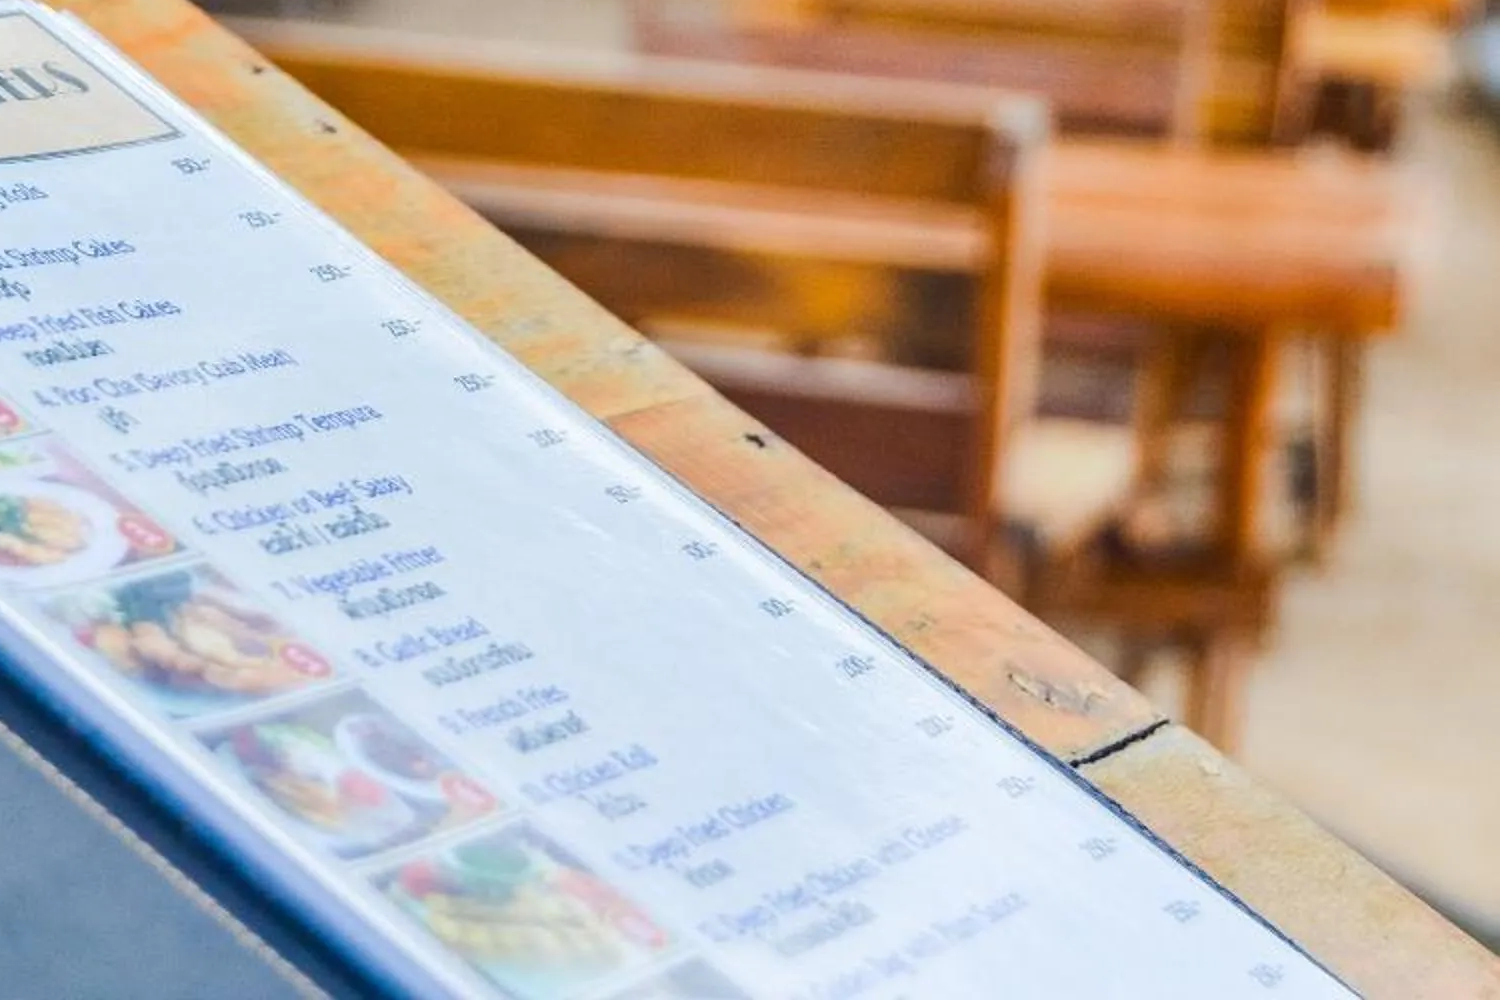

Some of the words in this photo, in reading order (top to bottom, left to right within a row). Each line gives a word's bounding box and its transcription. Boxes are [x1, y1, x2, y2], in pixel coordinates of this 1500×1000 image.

[3, 242, 79, 272] Shrimp
[72, 235, 137, 259] Cakes
[31, 314, 88, 339] Fried
[85, 308, 123, 333] Fish
[116, 296, 184, 321] Cakes
[197, 356, 251, 381] Crab
[129, 440, 195, 470] Deep
[183, 435, 242, 458] Fried
[235, 419, 304, 450] Shrimp
[298, 402, 384, 434] Tempura
[211, 502, 292, 533] Chicken
[289, 496, 316, 516] or
[308, 481, 357, 510] Beef
[356, 473, 415, 500] Satay
[294, 558, 393, 600] Vegetable
[425, 616, 491, 648] Bread
